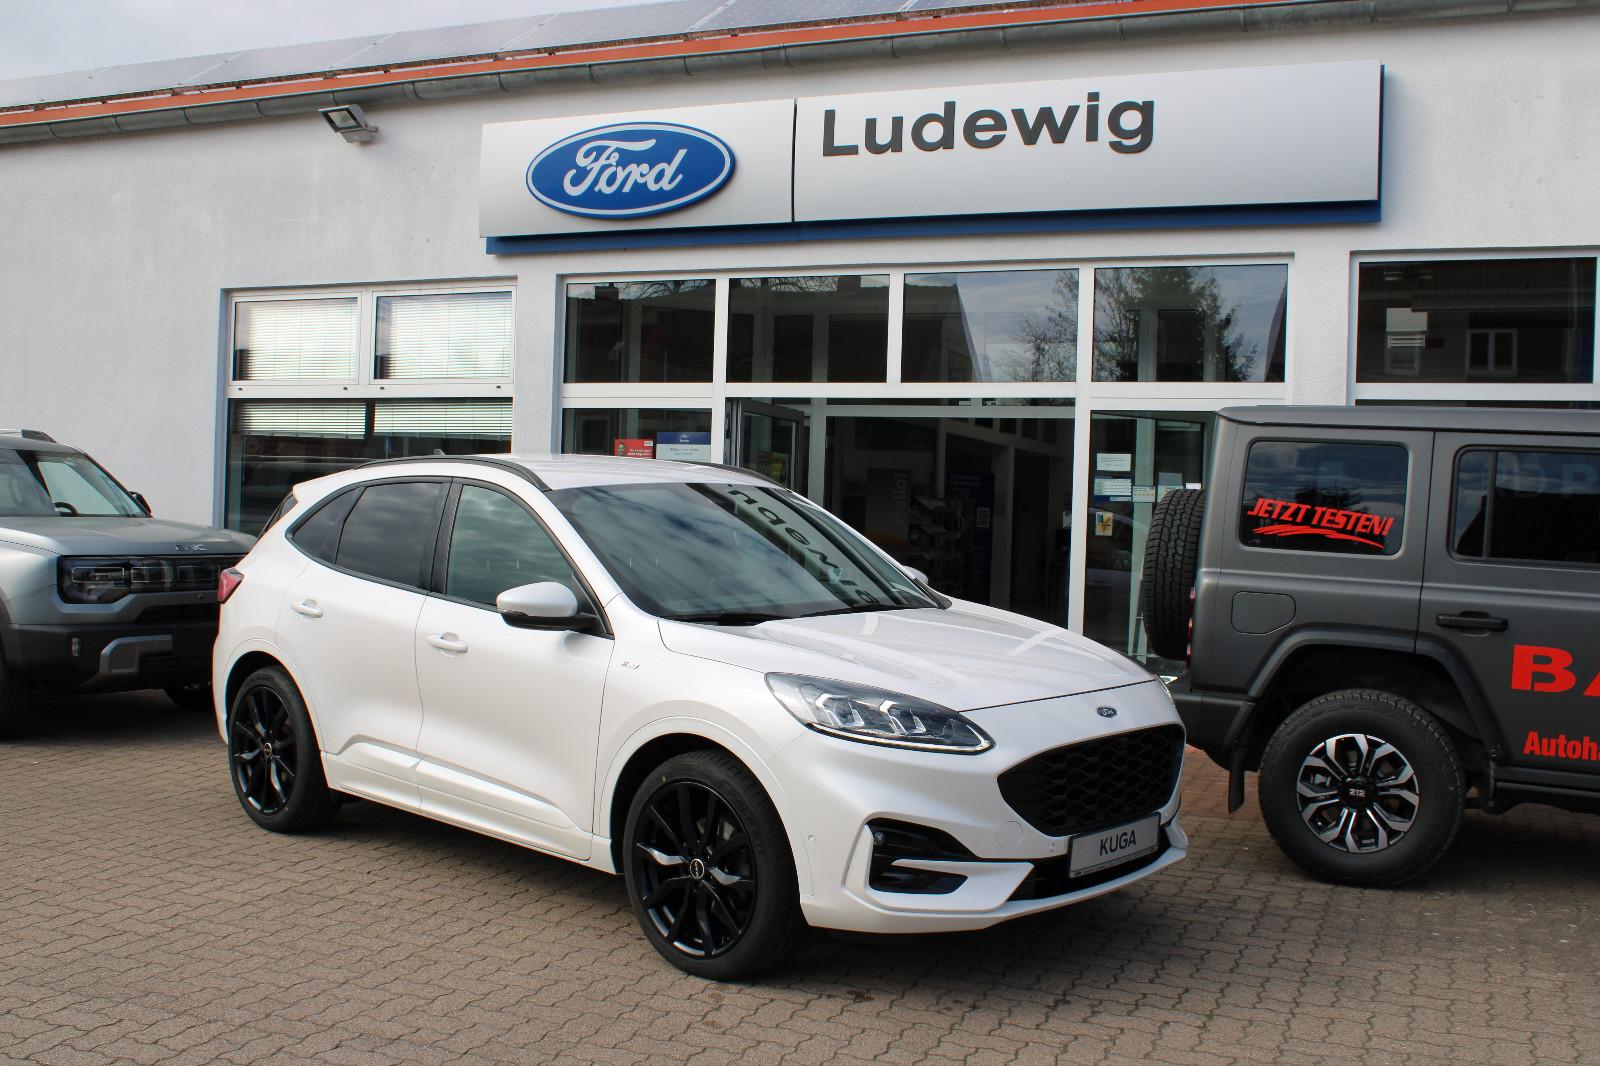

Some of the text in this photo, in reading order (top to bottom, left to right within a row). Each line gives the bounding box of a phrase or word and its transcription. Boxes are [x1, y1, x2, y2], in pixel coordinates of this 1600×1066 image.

[823, 92, 1155, 157] Ludewig
[563, 138, 687, 197] Ford
[1247, 497, 1394, 536] JETZT TESTEN!
[1511, 644, 1600, 697] B
[1523, 731, 1600, 761] Autoh
[1099, 830, 1137, 857] KUGA
